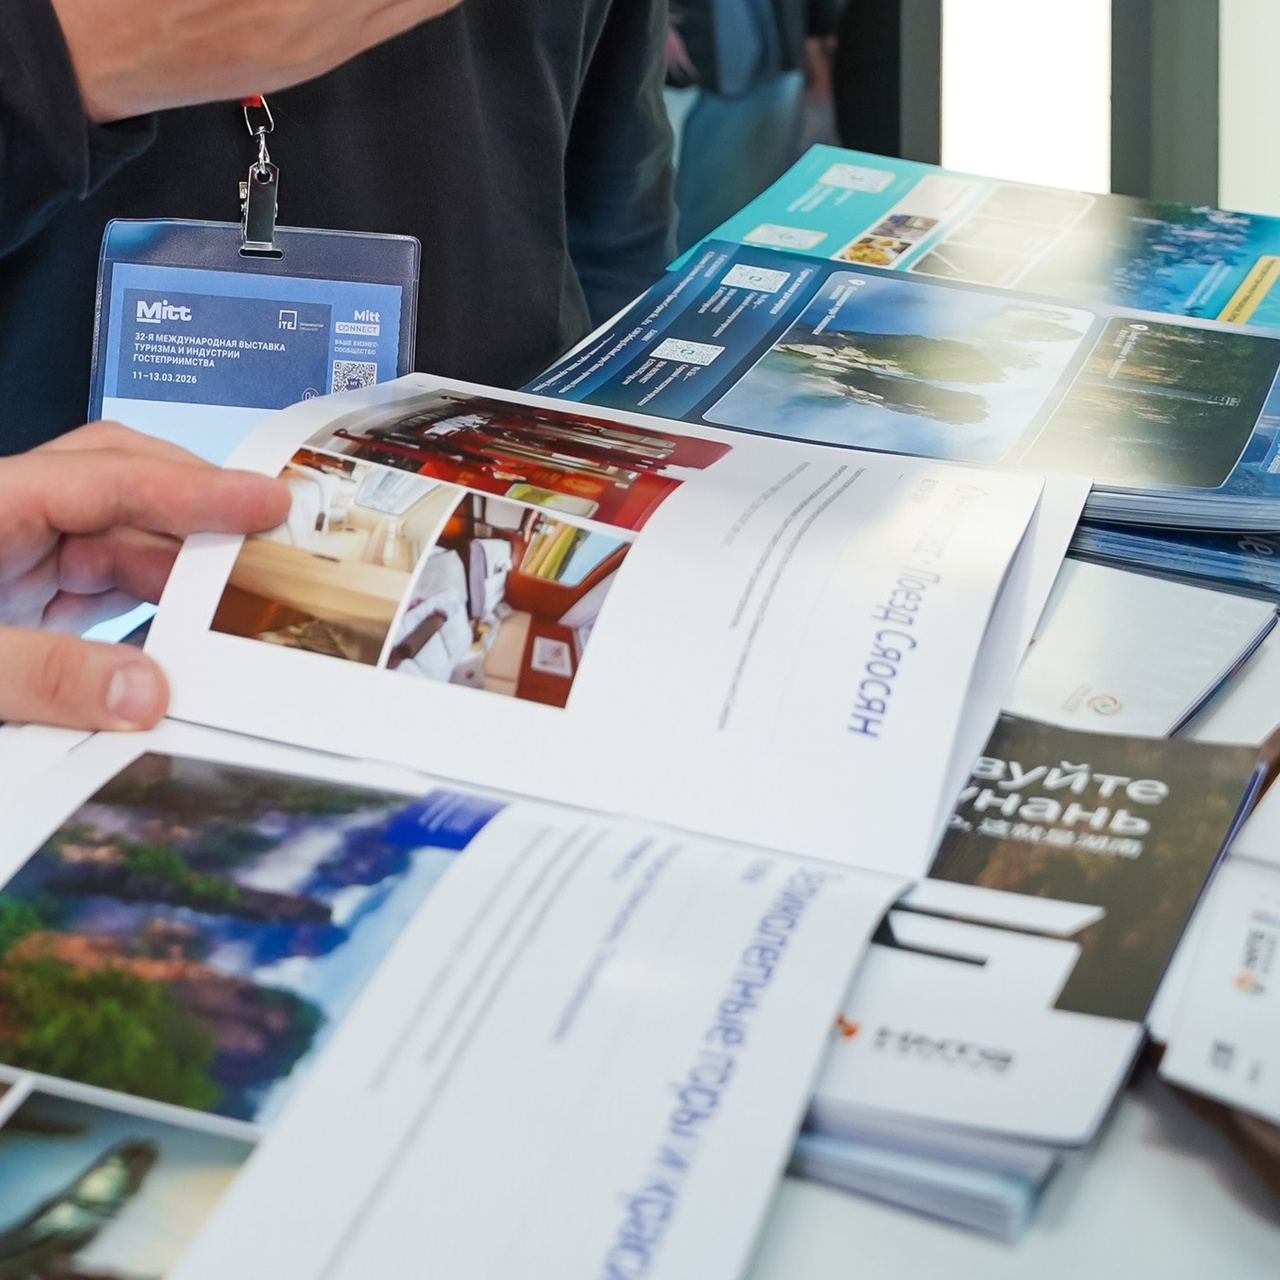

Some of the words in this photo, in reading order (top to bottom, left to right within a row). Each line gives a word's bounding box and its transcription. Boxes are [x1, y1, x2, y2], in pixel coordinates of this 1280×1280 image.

[136, 300, 192, 323] Mitt
[354, 309, 380, 322] Mitt
[337, 324, 377, 334] CONNECT
[134, 332, 154, 341] 32-Я
[156, 334, 237, 348] МЕЖДУНАРОДНАЯ
[239, 341, 286, 351] ВЫСТАВКА
[134, 343, 176, 354] ТУРИЗМА
[178, 346, 185, 355] И
[186, 347, 240, 359] ИНДУСТРИИ
[334, 346, 376, 355] СООБЩЕСТВО
[133, 354, 215, 368] ГОСТЕПРИИМСТВА
[871, 565, 942, 628] Поезд
[847, 628, 918, 739] Сяосян
